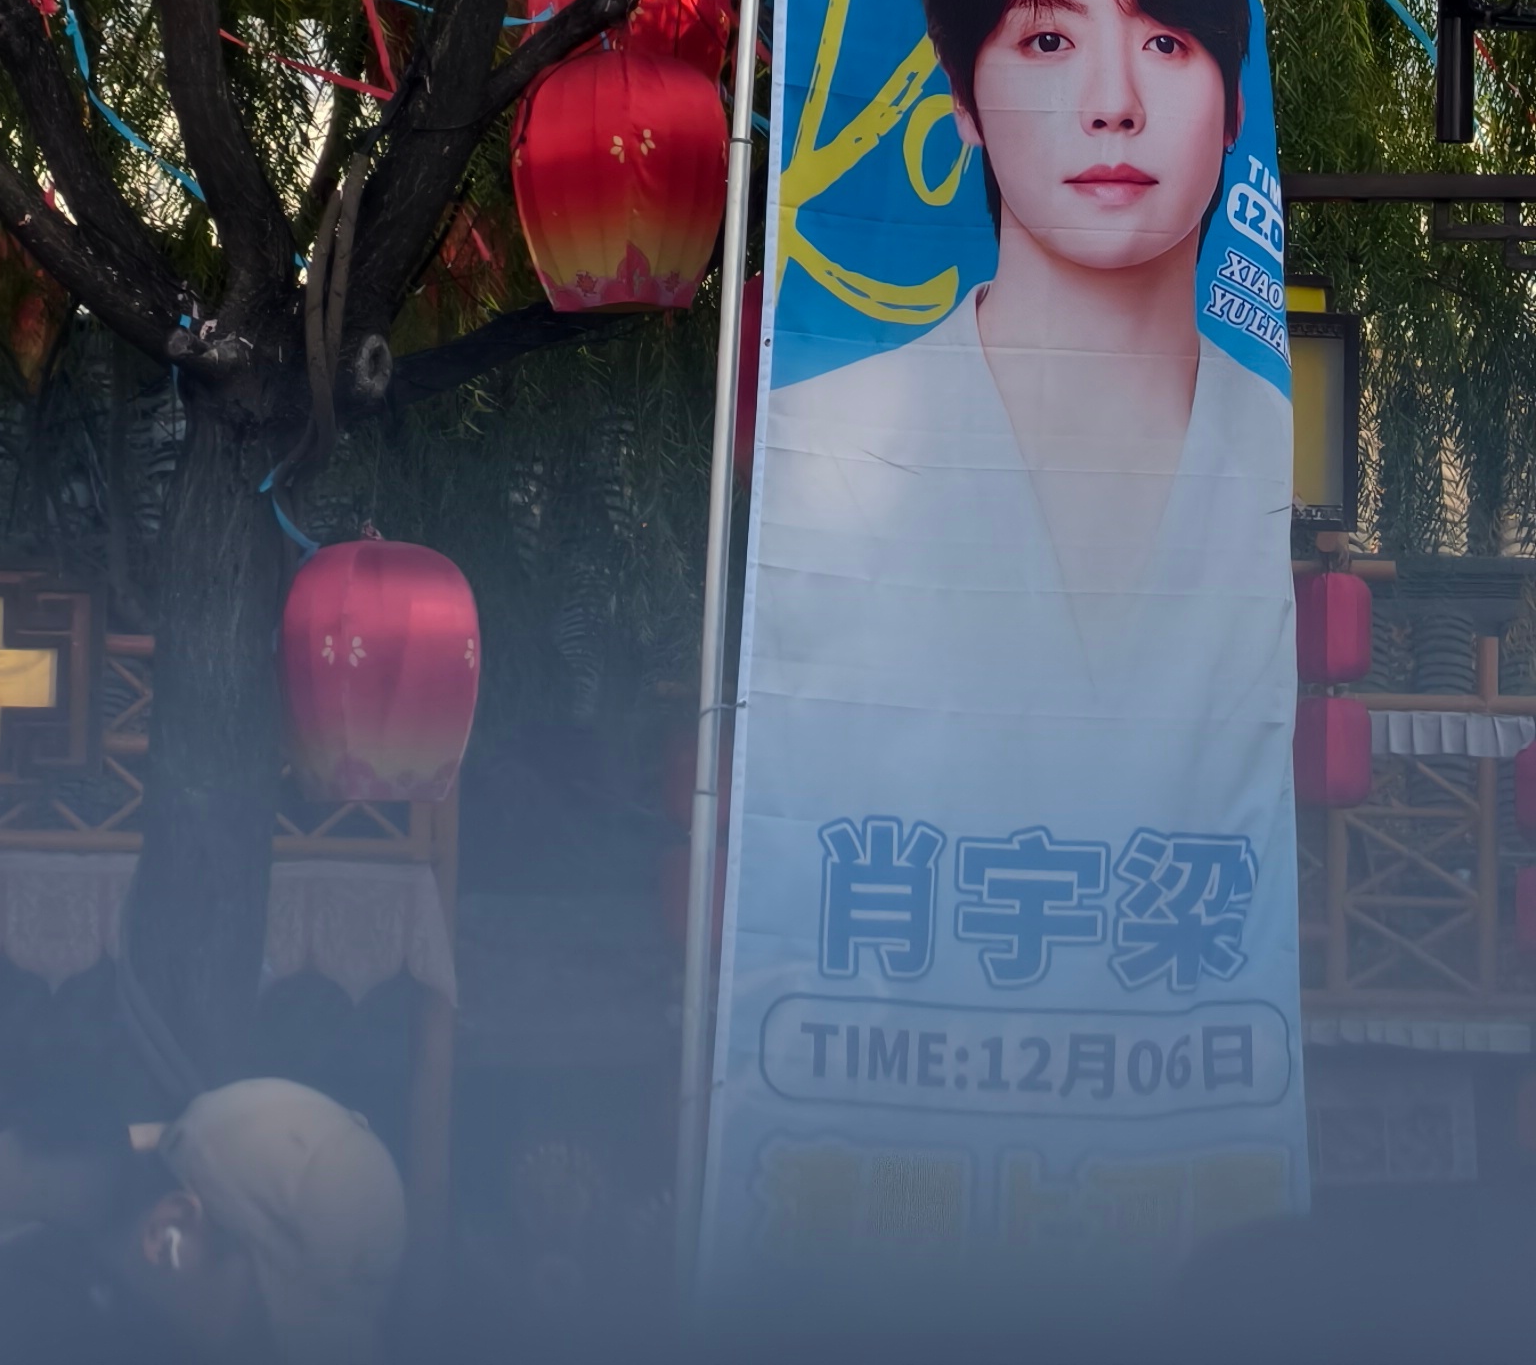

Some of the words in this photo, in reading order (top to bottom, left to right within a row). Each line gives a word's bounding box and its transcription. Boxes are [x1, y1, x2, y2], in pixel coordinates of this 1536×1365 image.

[1219, 251, 1284, 310] XIAO
[818, 815, 1259, 994] 肖宇梁
[800, 1021, 1255, 1100] TIME:12月06日
